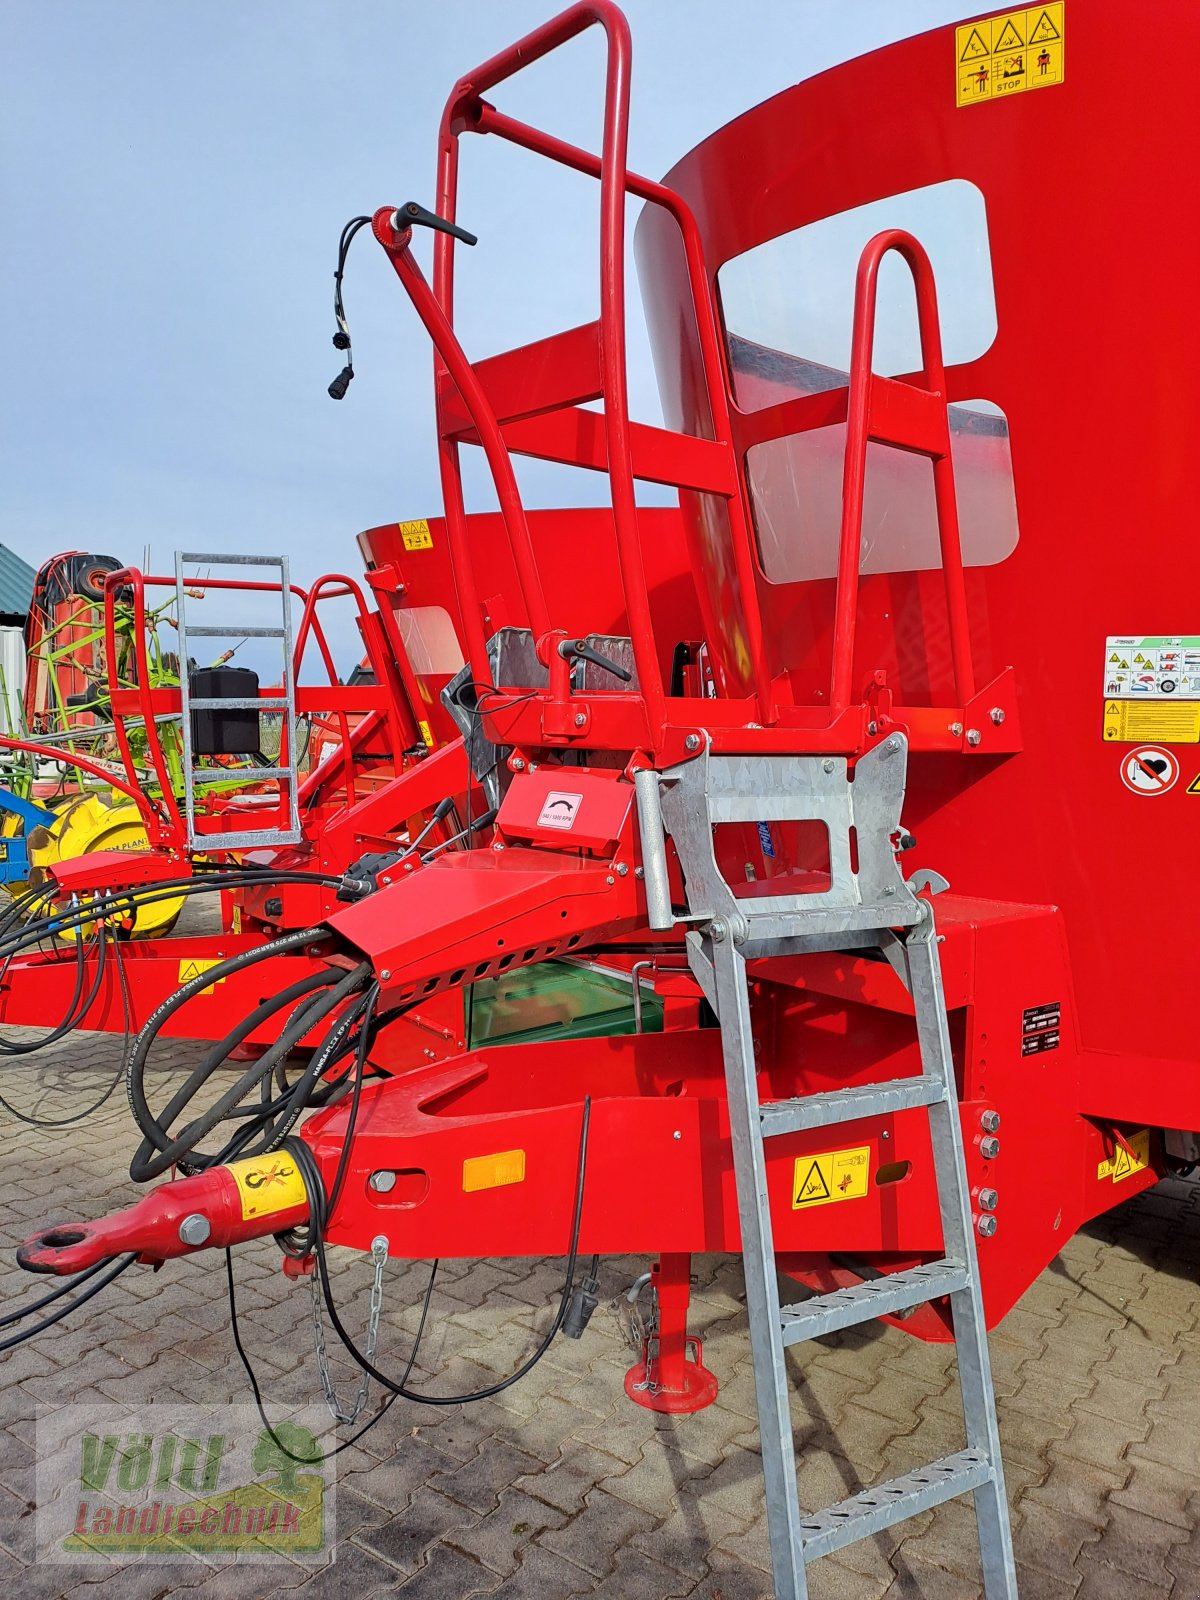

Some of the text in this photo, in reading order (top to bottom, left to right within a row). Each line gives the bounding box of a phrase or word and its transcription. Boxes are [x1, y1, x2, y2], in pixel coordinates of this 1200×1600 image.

[997, 80, 1021, 92] STOP
[275, 939, 287, 947] 275
[165, 975, 203, 1006] HANSA-FLEX
[157, 1004, 166, 1015] KP
[147, 1012, 158, 1023] 213
[136, 1023, 149, 1042] EN857
[130, 1041, 138, 1055] 2SC
[313, 1035, 339, 1076] HANSA-FLEX
[337, 1025, 346, 1036] KP
